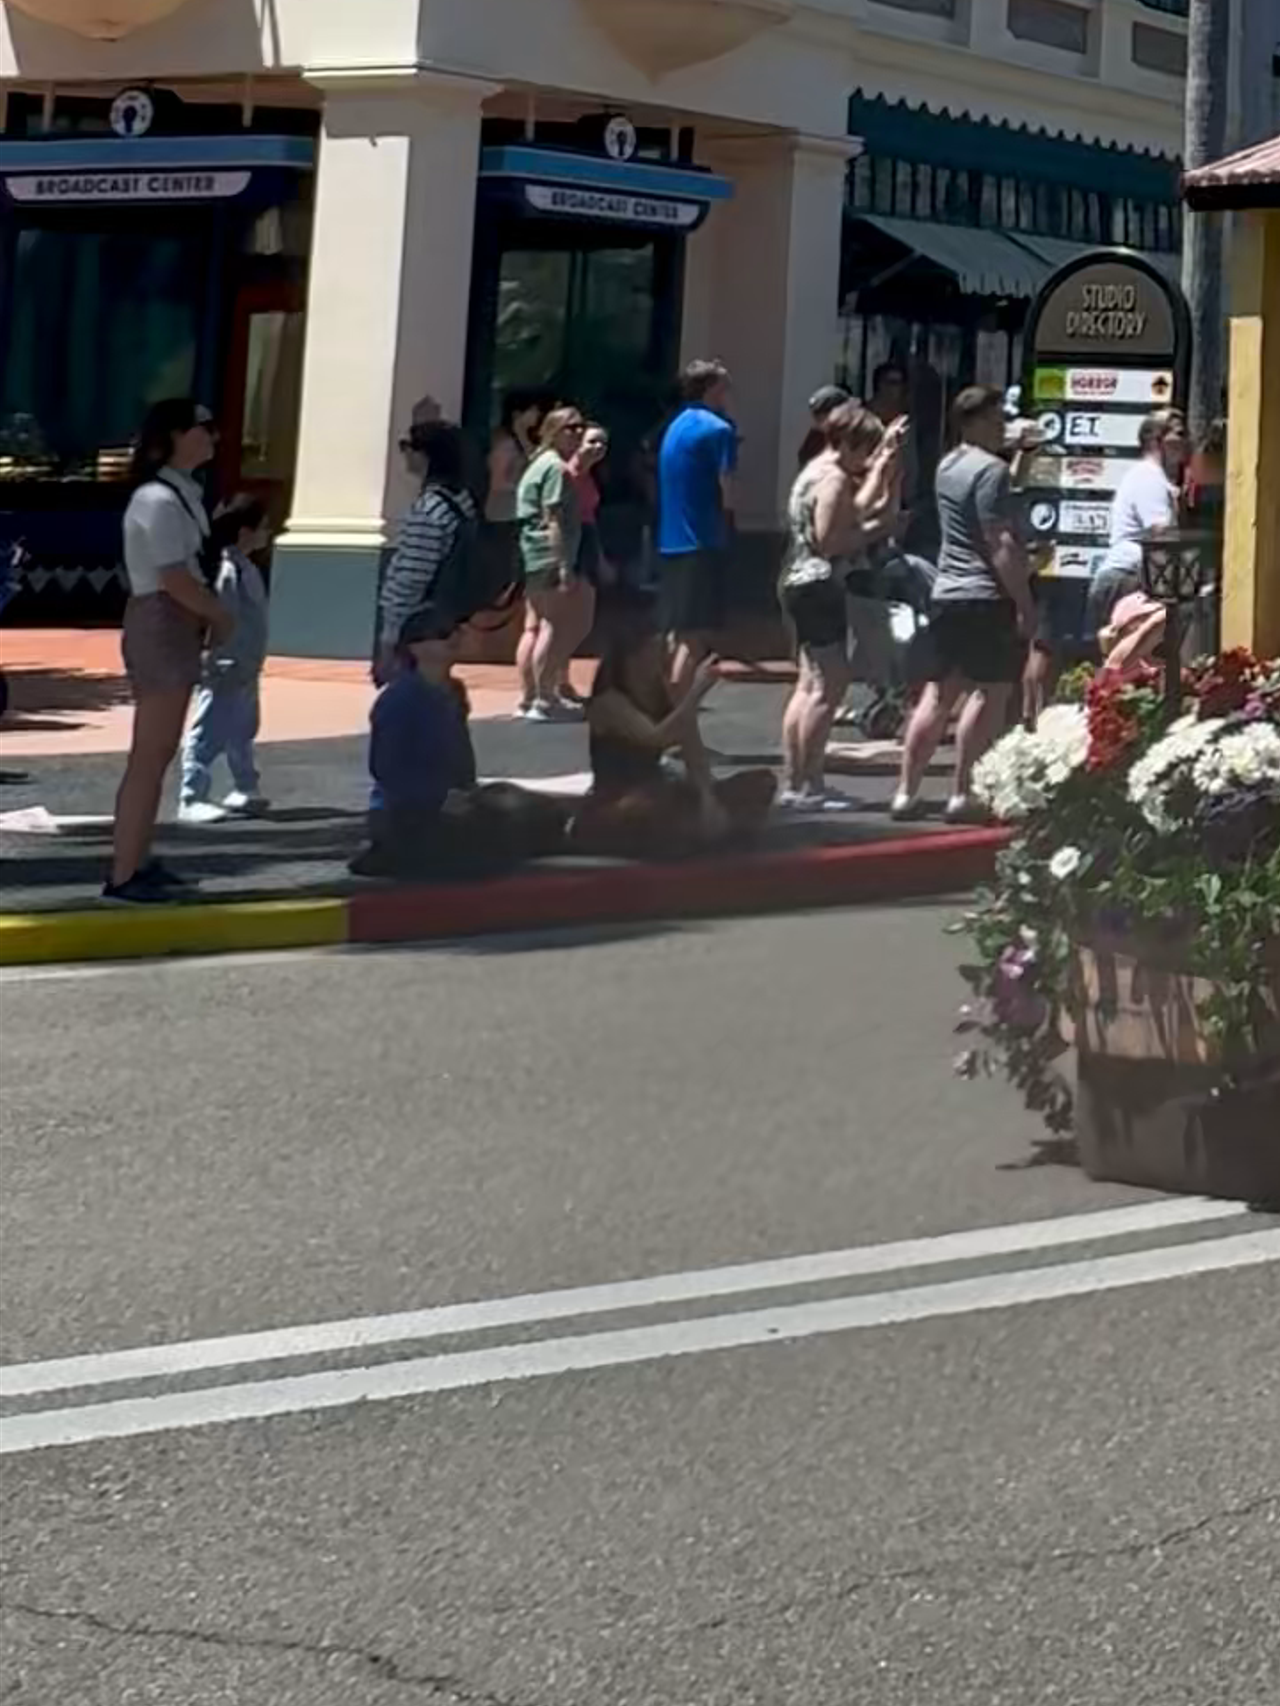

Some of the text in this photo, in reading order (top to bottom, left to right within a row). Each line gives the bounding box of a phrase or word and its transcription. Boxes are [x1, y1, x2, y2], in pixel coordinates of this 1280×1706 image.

[35, 175, 215, 195] BROADCAST CENTER
[1081, 284, 1135, 310] STUDIO
[1065, 311, 1146, 336] DIRECTORY
